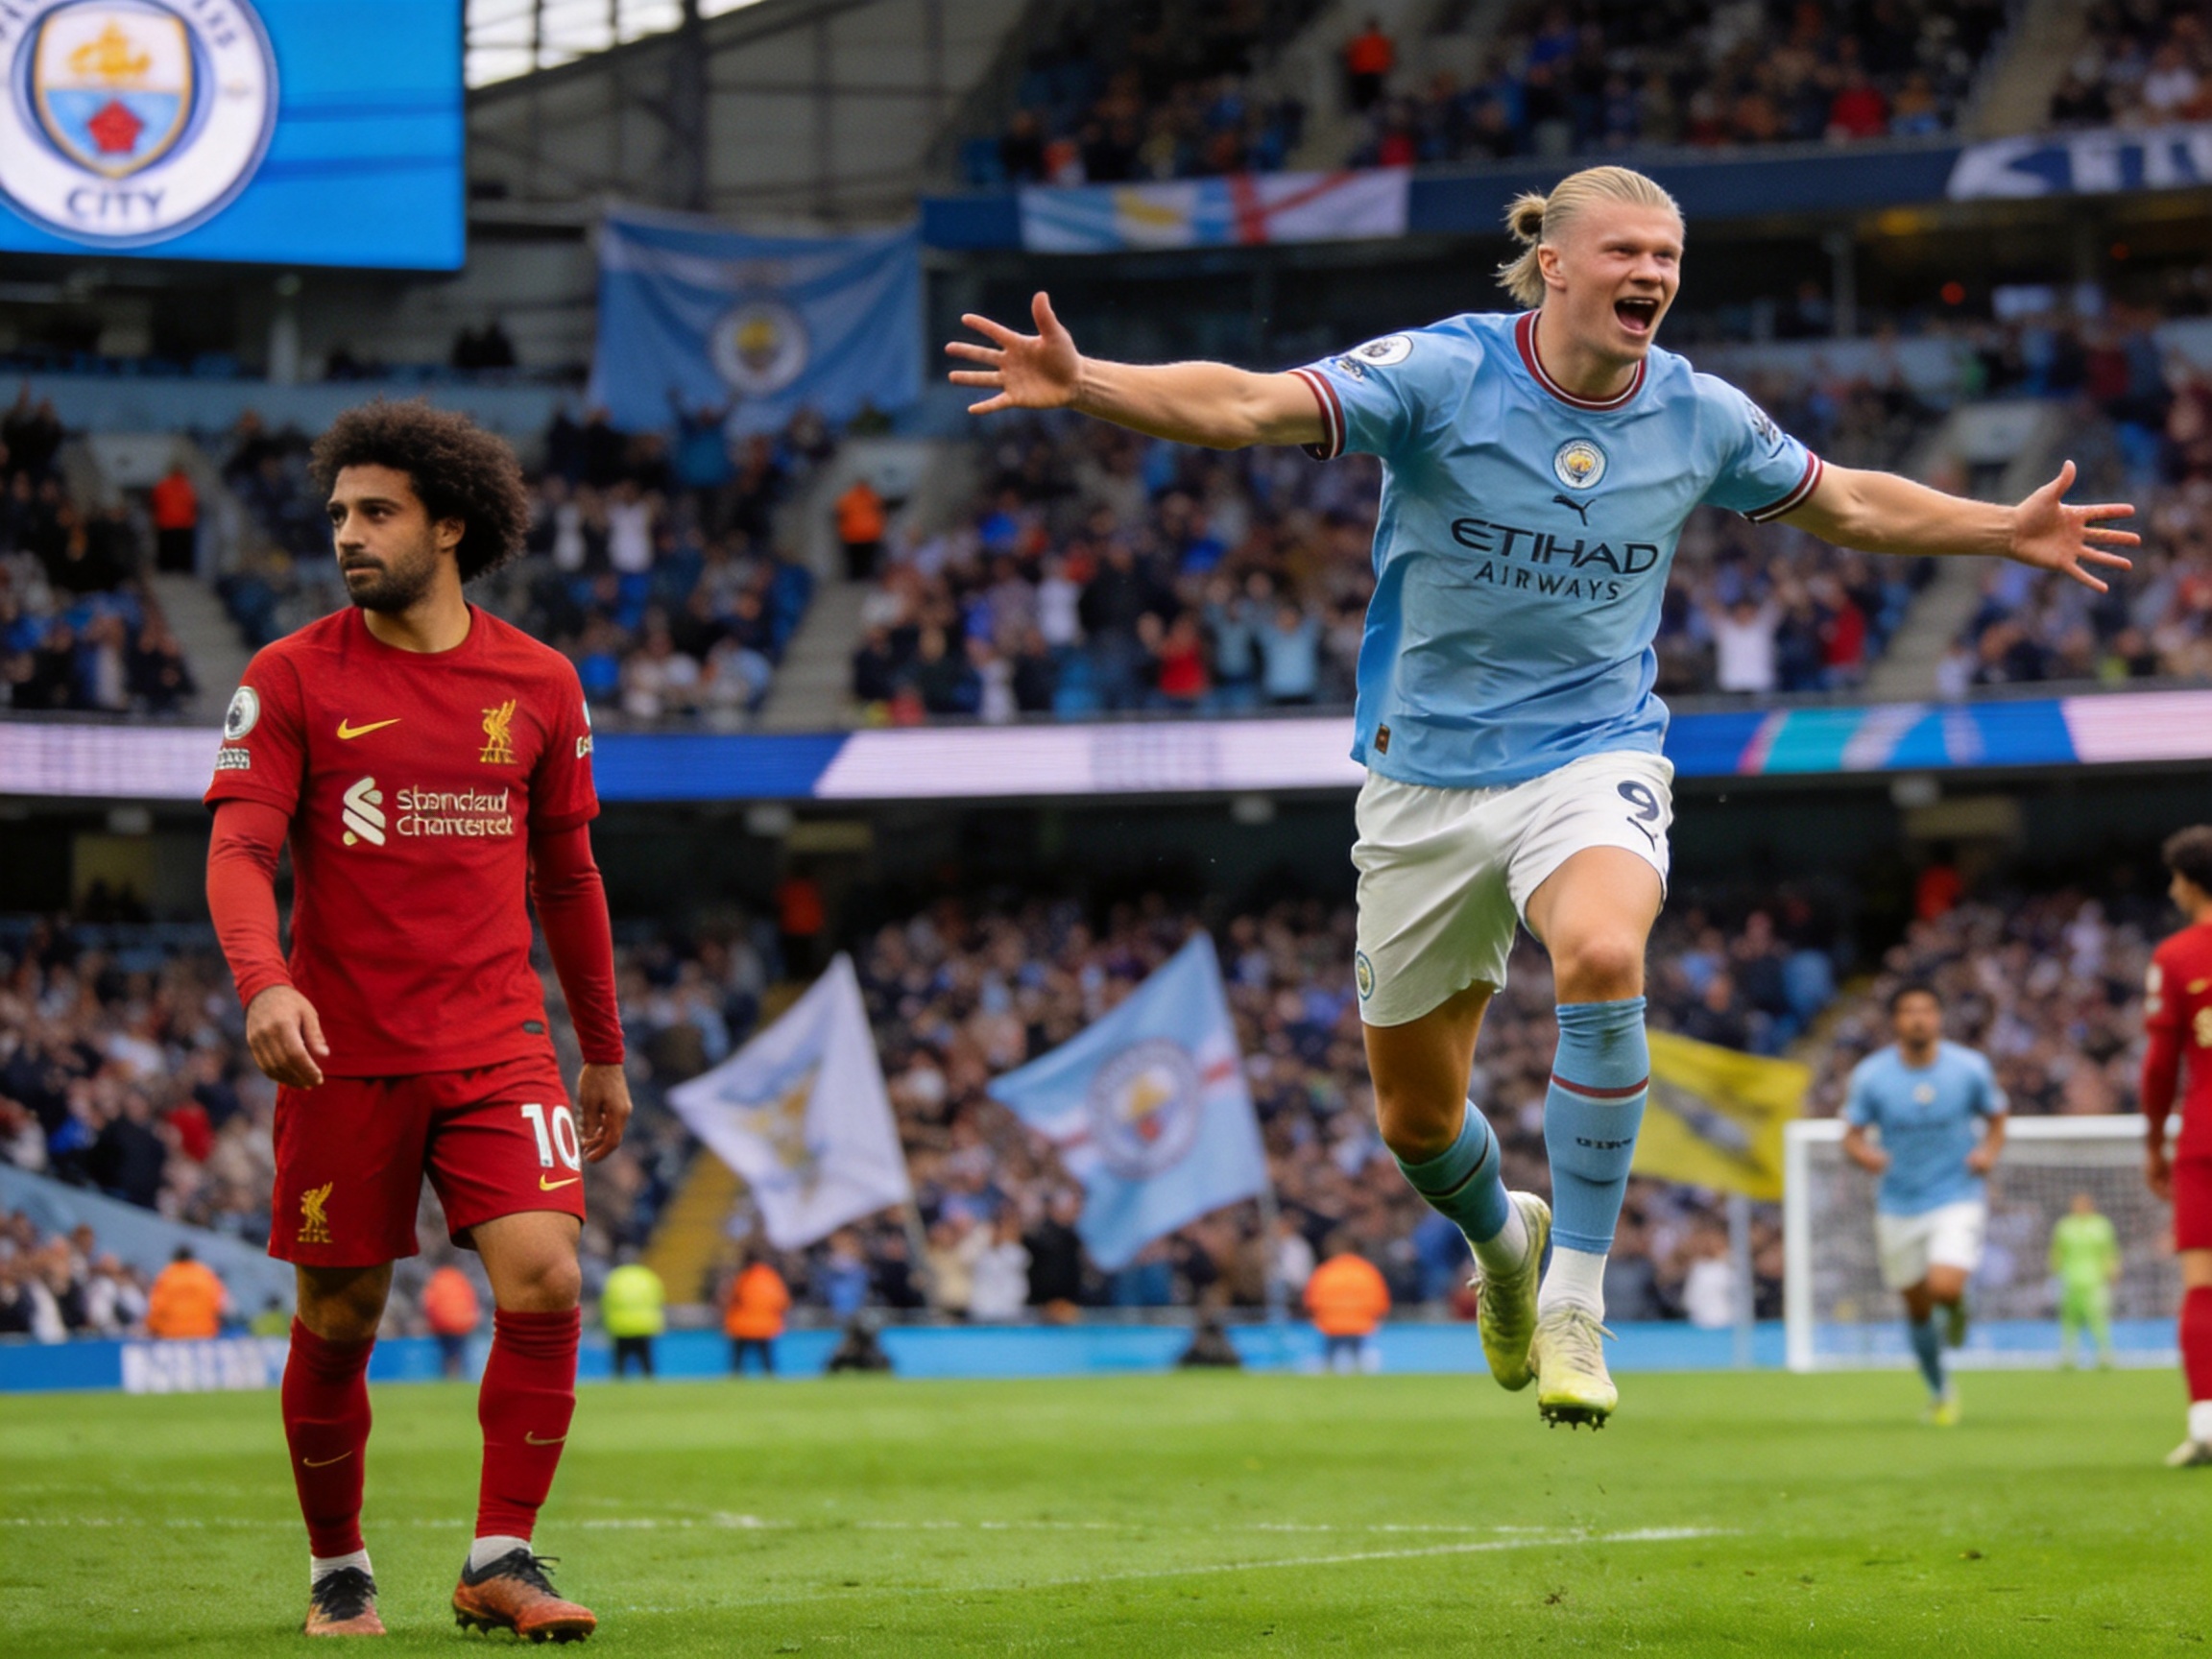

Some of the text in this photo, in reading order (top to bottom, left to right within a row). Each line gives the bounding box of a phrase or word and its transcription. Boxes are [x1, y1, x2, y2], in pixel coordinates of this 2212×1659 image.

[65, 187, 167, 219] CITY
[1451, 517, 1659, 574] ETIHAD
[1474, 561, 1621, 600] AIRWAYS
[1617, 780, 1660, 822] 9
[520, 1103, 581, 1171] 10
